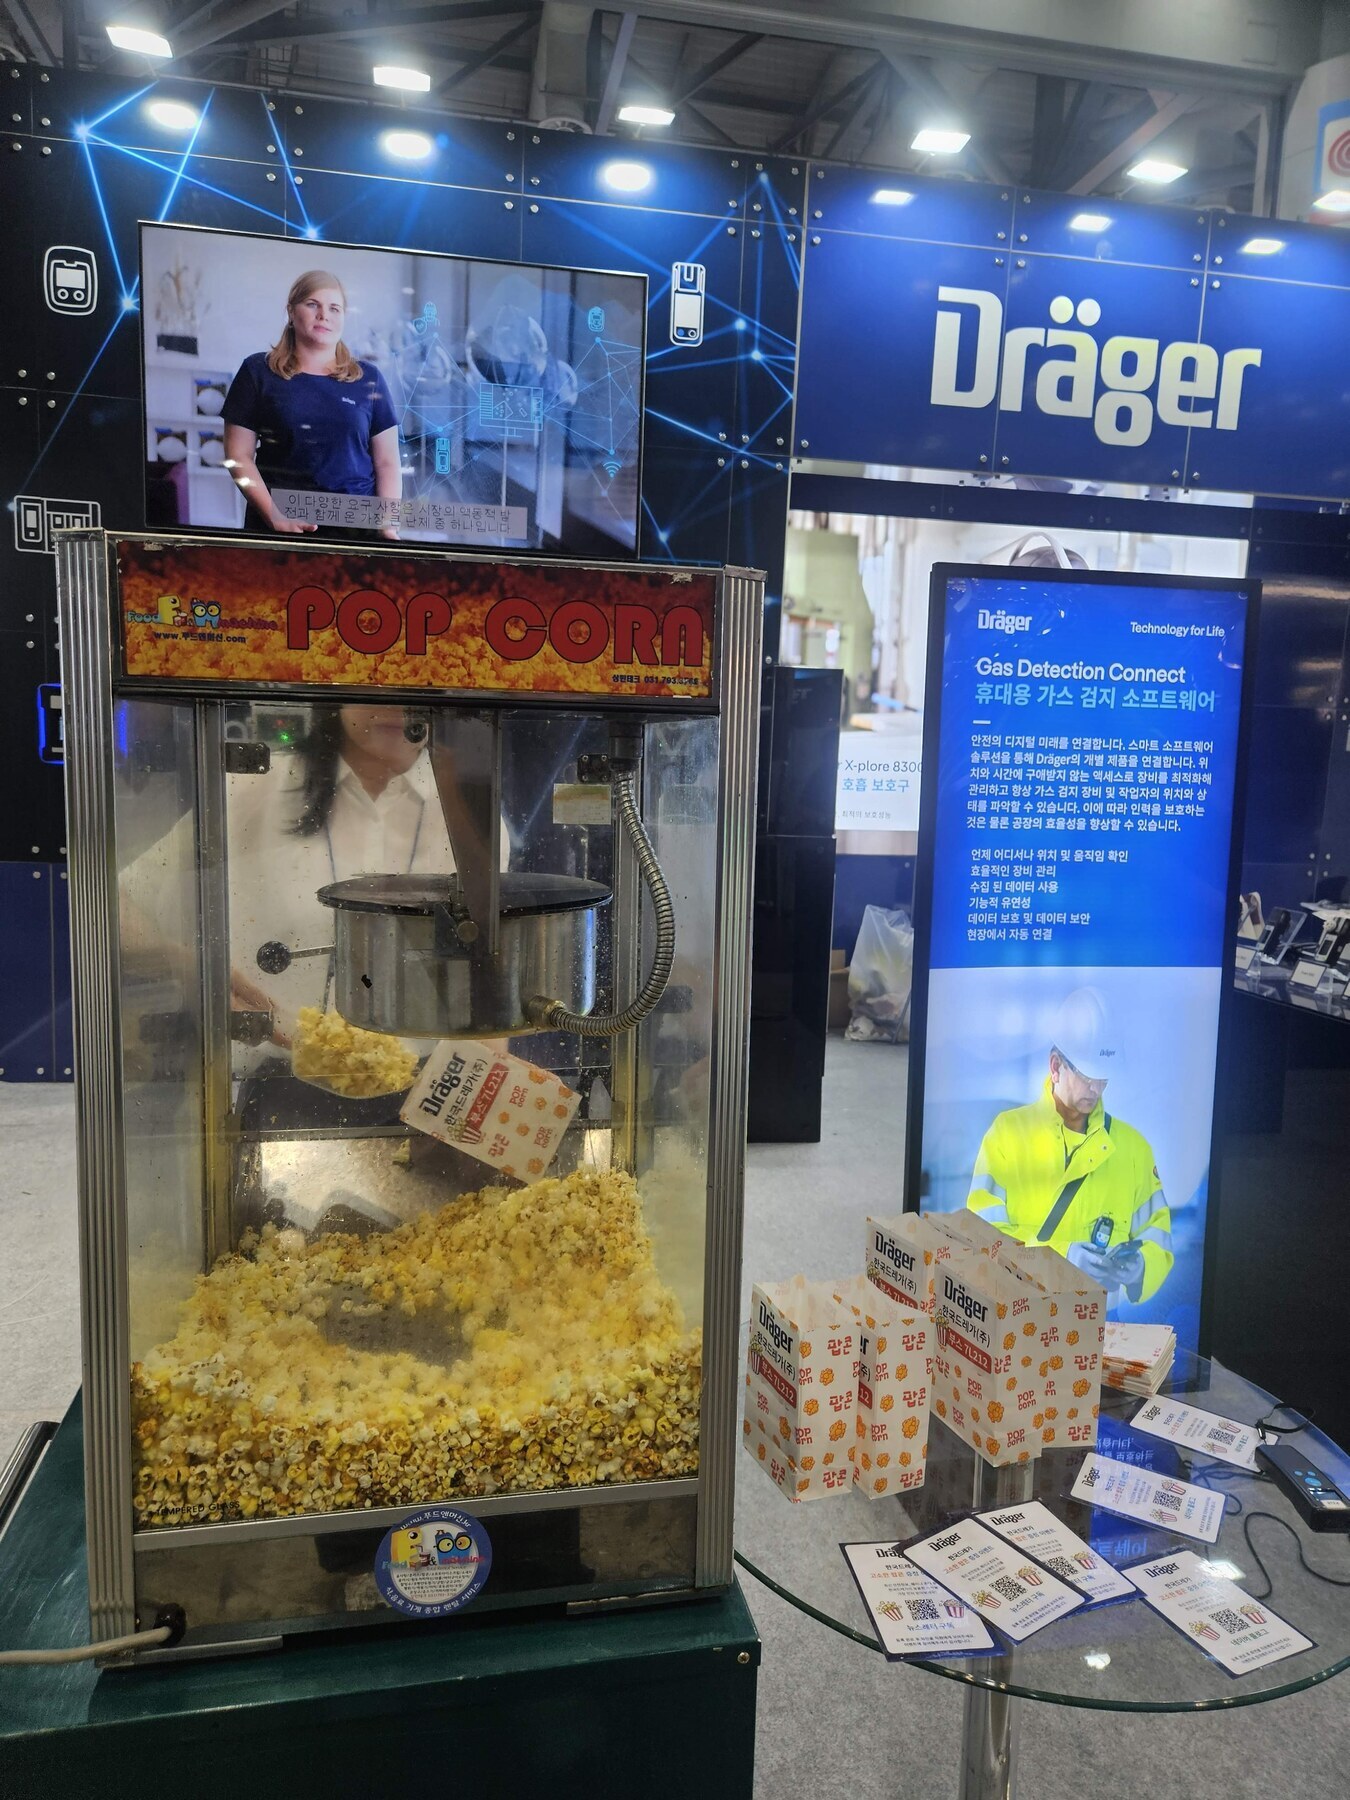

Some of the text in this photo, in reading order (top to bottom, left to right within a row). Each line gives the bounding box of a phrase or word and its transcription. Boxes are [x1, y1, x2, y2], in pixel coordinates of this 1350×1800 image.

[930, 286, 1261, 446] Dräger
[286, 585, 704, 668] POP CORN
[977, 608, 1032, 634] Dräger
[1130, 621, 1226, 638] Technology for Life
[976, 656, 1186, 684] Gas Detection Connect
[975, 682, 1216, 712] 휴대용 가스 검지 소프트웨어
[971, 734, 1214, 754] 안전의 디지털 미래를 연결합니다. 스마트 소프트웨어
[844, 760, 890, 774] X-plore
[970, 750, 1208, 769] 솔루션을 통해 Dräger의 개별 제품을 연결합니다. 위
[970, 767, 1212, 785] 치와 시간에 구애받지 않는 액세스로 장비를 최적화해
[842, 778, 910, 794] 호흡 보호구
[968, 784, 1208, 801] 관리하고 항상 가스 검지 장비 및 작업자의 위치와 상
[967, 800, 1206, 816] 태를 파악할 수 있습니다. 이에 따라 인력을 보호하는
[966, 816, 1181, 832] 것은 물론 공장의 효율성을 향상할 수 있습니다.
[971, 848, 1128, 862] 언제 어디서나 위치 및 움직임 확인
[970, 865, 1056, 878] 효율적인 장비 관리
[970, 880, 1058, 894] 수집 된 데이터 사용
[969, 896, 1031, 909] 기능적 유연성
[968, 912, 1090, 925] 데이터 보호 및 데이터 보안
[968, 928, 1052, 942] 현장에서 자동 연결
[418, 1052, 467, 1118] Dräger
[444, 1058, 488, 1126] 한국드레가(주)
[484, 1069, 506, 1102] 7L212
[510, 1085, 522, 1106] POP
[488, 1133, 510, 1158] 팝콘
[876, 1231, 916, 1272] Dräger
[874, 1257, 917, 1295] 한국드레가(주)
[944, 1276, 988, 1322] Dräger
[1012, 1305, 1030, 1317] corn
[1074, 1302, 1098, 1320] 팝콘
[759, 1300, 794, 1354] Dräger
[942, 1304, 990, 1348] 한국드레가(주)
[828, 1336, 852, 1356] 팝콘
[902, 1332, 926, 1352] 팝콘
[948, 1330, 988, 1368] 부스 7L212
[757, 1331, 796, 1381] 한국드레가(주)
[1074, 1353, 1098, 1371] 팝콘
[762, 1360, 794, 1402] 부스 7L212
[968, 1377, 982, 1391] POP
[829, 1390, 852, 1412] 팝콘
[902, 1387, 926, 1408] 팝콘
[968, 1387, 982, 1400] corn
[1017, 1390, 1035, 1404] POP
[952, 1406, 964, 1420] POP
[1018, 1398, 1036, 1410] corn
[1142, 1404, 1162, 1421] Dräger
[1006, 1428, 1025, 1442] POP
[1007, 1436, 1025, 1448] corn
[1068, 1424, 1091, 1442] 팝콘
[770, 1458, 786, 1486] 팝콘
[822, 1468, 846, 1489] 팝콘
[900, 1468, 923, 1489] 팝콘
[1082, 1466, 1100, 1488] Dräger
[156, 1500, 240, 1516] TEMPERED GLASS
[990, 1512, 1026, 1526] Dräger
[928, 1532, 962, 1552] Dräger
[428, 1556, 438, 1566] &
[948, 1546, 974, 1561] 한국드레가
[1144, 1562, 1180, 1578] Dräger
[1010, 1596, 1032, 1613] 뉴스레터
[1032, 1591, 1046, 1604] 구독
[907, 1622, 954, 1632] 뉴스레터 구독
[1230, 1628, 1269, 1646] 네이버 블로그
